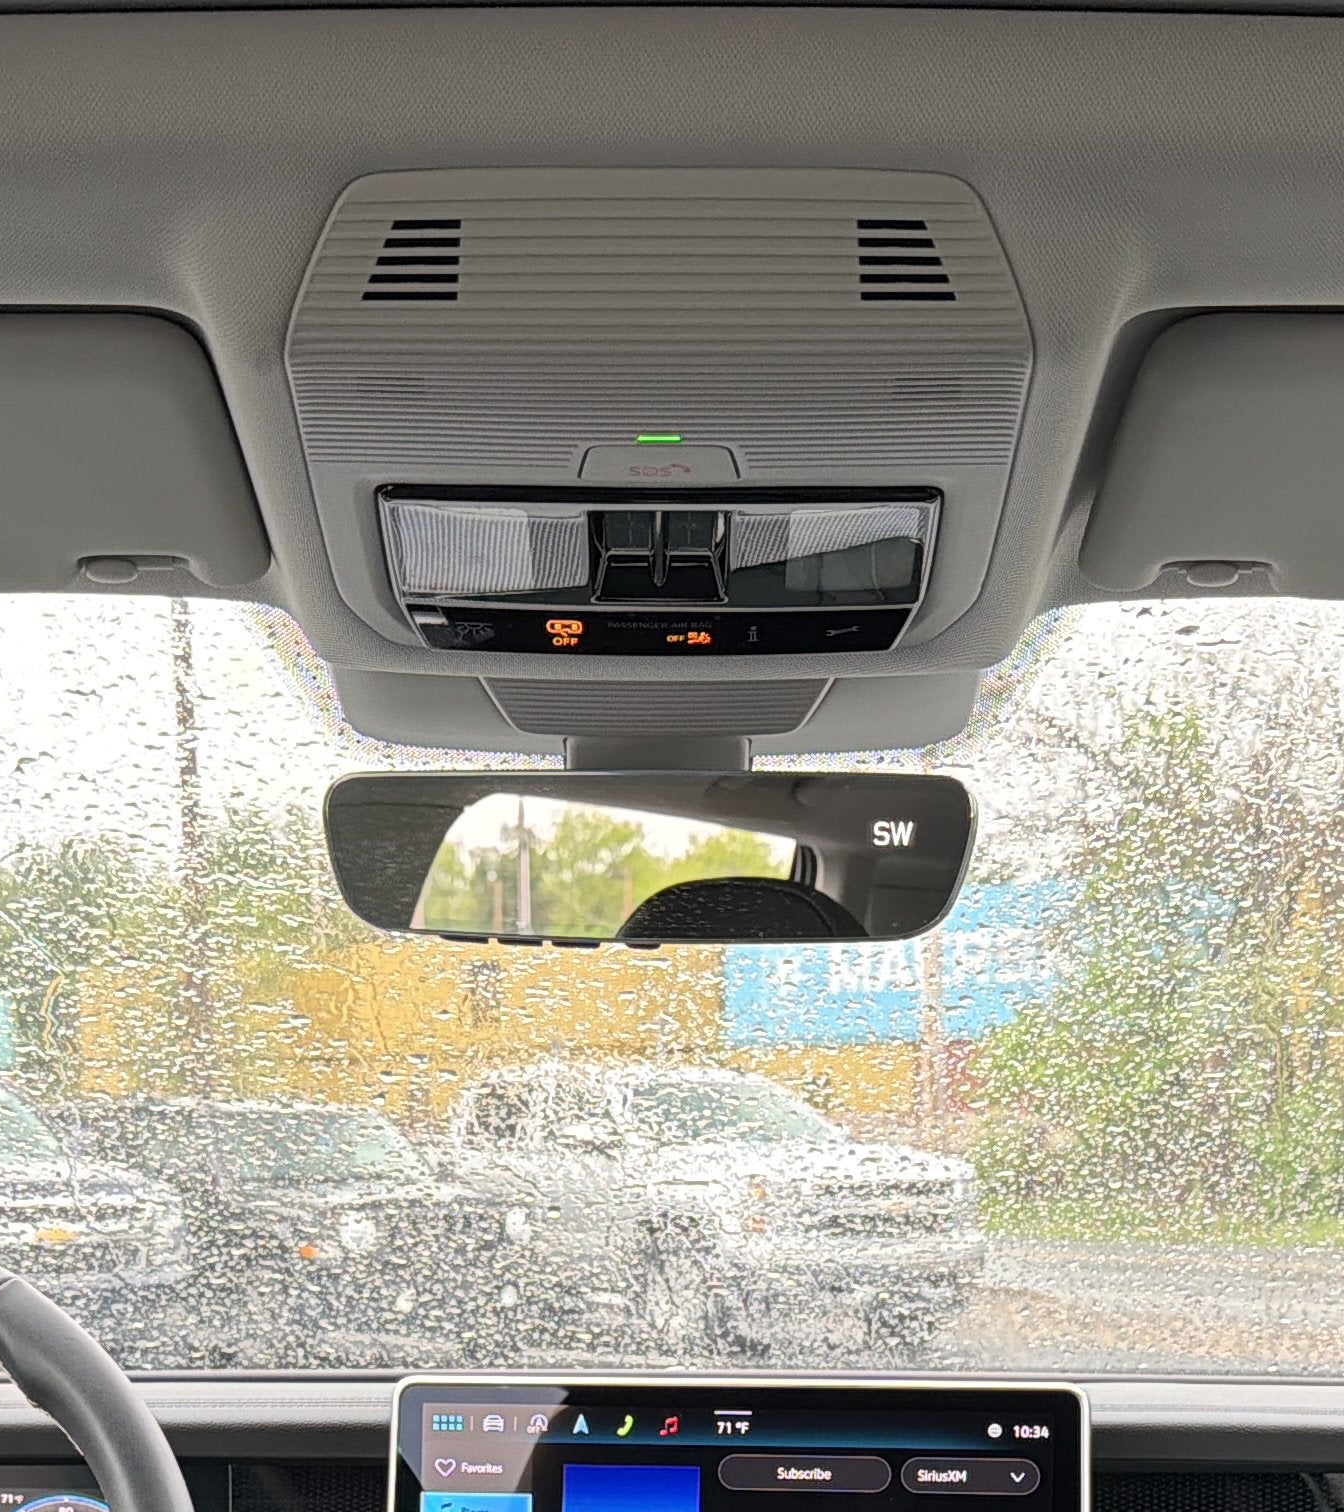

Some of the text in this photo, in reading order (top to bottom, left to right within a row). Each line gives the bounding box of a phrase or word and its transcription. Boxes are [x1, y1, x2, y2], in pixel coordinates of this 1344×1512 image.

[629, 466, 672, 477] SOS
[552, 636, 579, 646] OFF
[666, 634, 685, 643] OFF
[872, 820, 916, 847] SW
[1013, 1424, 1050, 1439] 10:34
[460, 1461, 504, 1475] Favorites
[776, 1466, 833, 1481] Subscribe
[917, 1469, 968, 1484] SiriusXM
